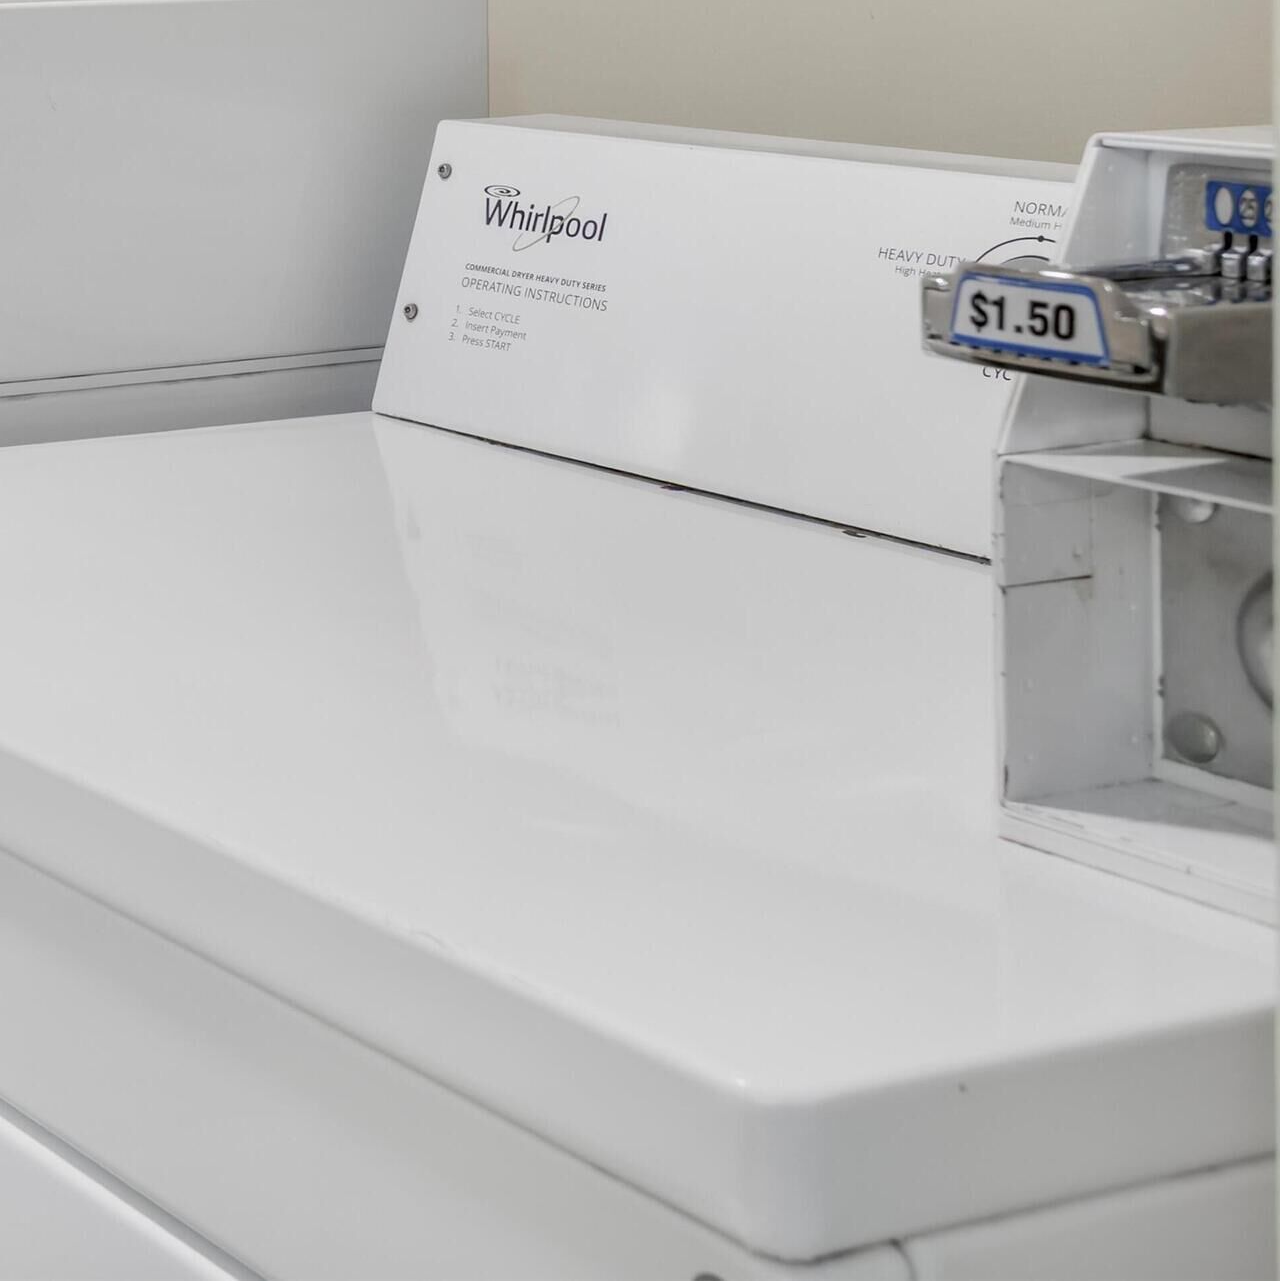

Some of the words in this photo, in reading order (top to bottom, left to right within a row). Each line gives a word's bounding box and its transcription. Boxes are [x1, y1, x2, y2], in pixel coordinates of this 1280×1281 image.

[1014, 200, 1069, 217] NORM
[485, 197, 608, 243] Whirlpool
[1009, 217, 1051, 229] Medium
[878, 246, 924, 264] HEAVY
[465, 262, 510, 277] COMMERCIAL
[511, 270, 534, 281] DRYER
[535, 274, 560, 285] HEAVY
[560, 278, 581, 289] DUTY
[582, 281, 607, 293] SERIES
[895, 265, 916, 277] High
[461, 276, 522, 297] OPERATING
[524, 287, 608, 312] INSTRUCTIONS
[468, 307, 493, 320] Select
[494, 312, 521, 325] CYCLE
[969, 290, 1076, 341] $1.50
[465, 320, 489, 334] Insert
[490, 325, 527, 340] Payment
[462, 334, 484, 347] Press
[485, 339, 511, 351] START
